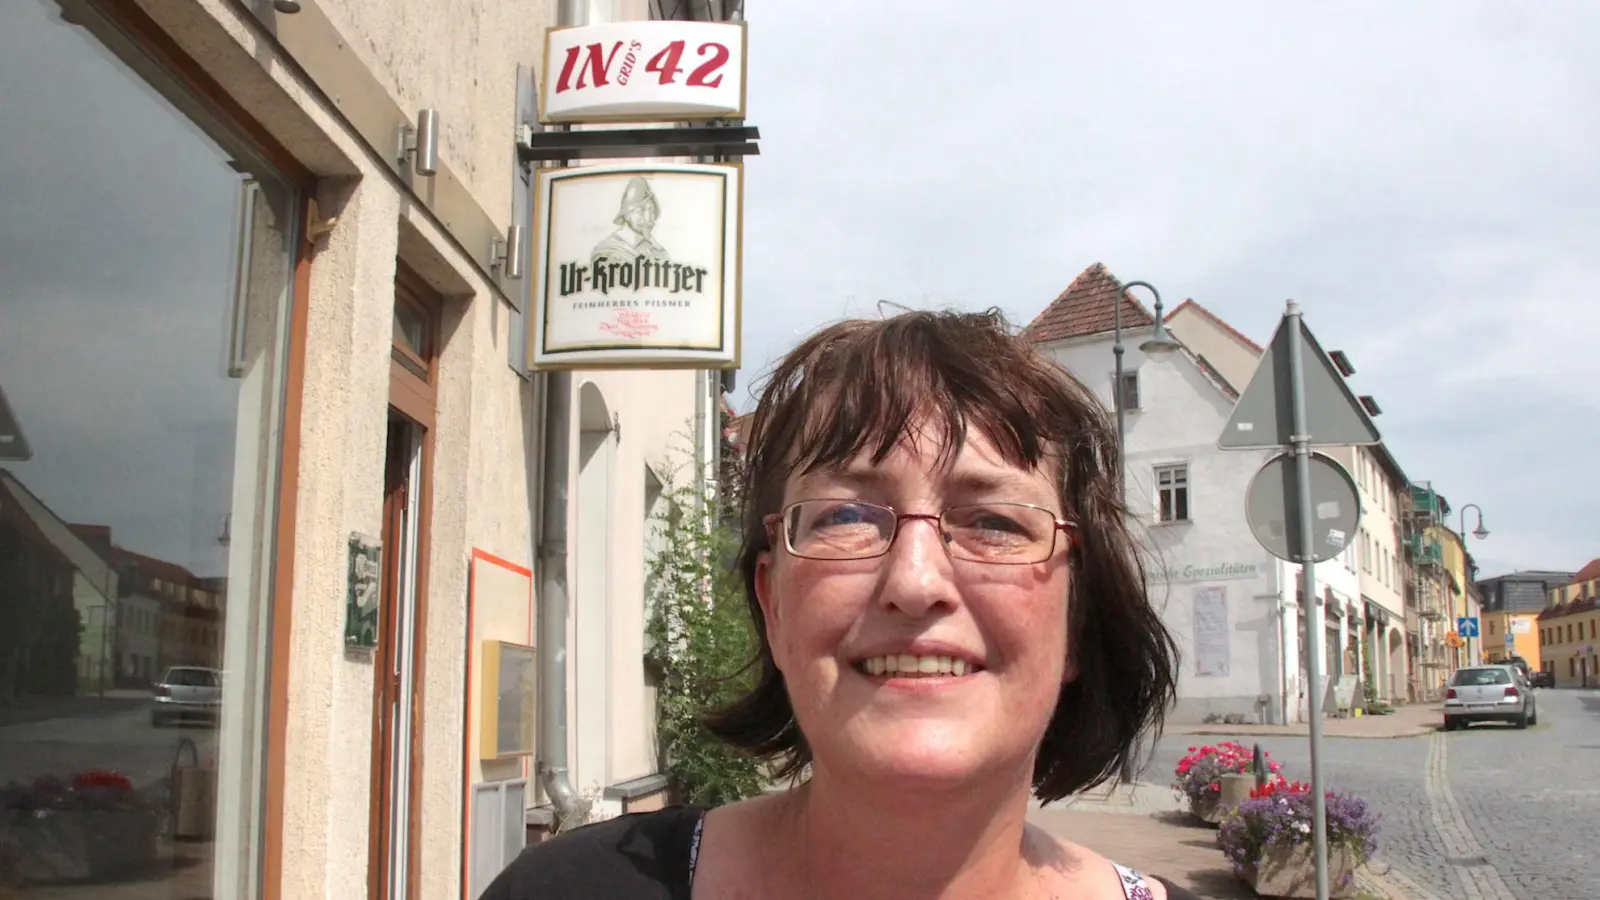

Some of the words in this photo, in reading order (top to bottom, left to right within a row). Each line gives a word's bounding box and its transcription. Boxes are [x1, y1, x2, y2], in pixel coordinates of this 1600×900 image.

[556, 41, 623, 94] IN
[616, 39, 642, 86] GRID'S
[645, 40, 730, 88] 42
[573, 300, 639, 310] FEINHERBES
[644, 299, 690, 308] PILSNER
